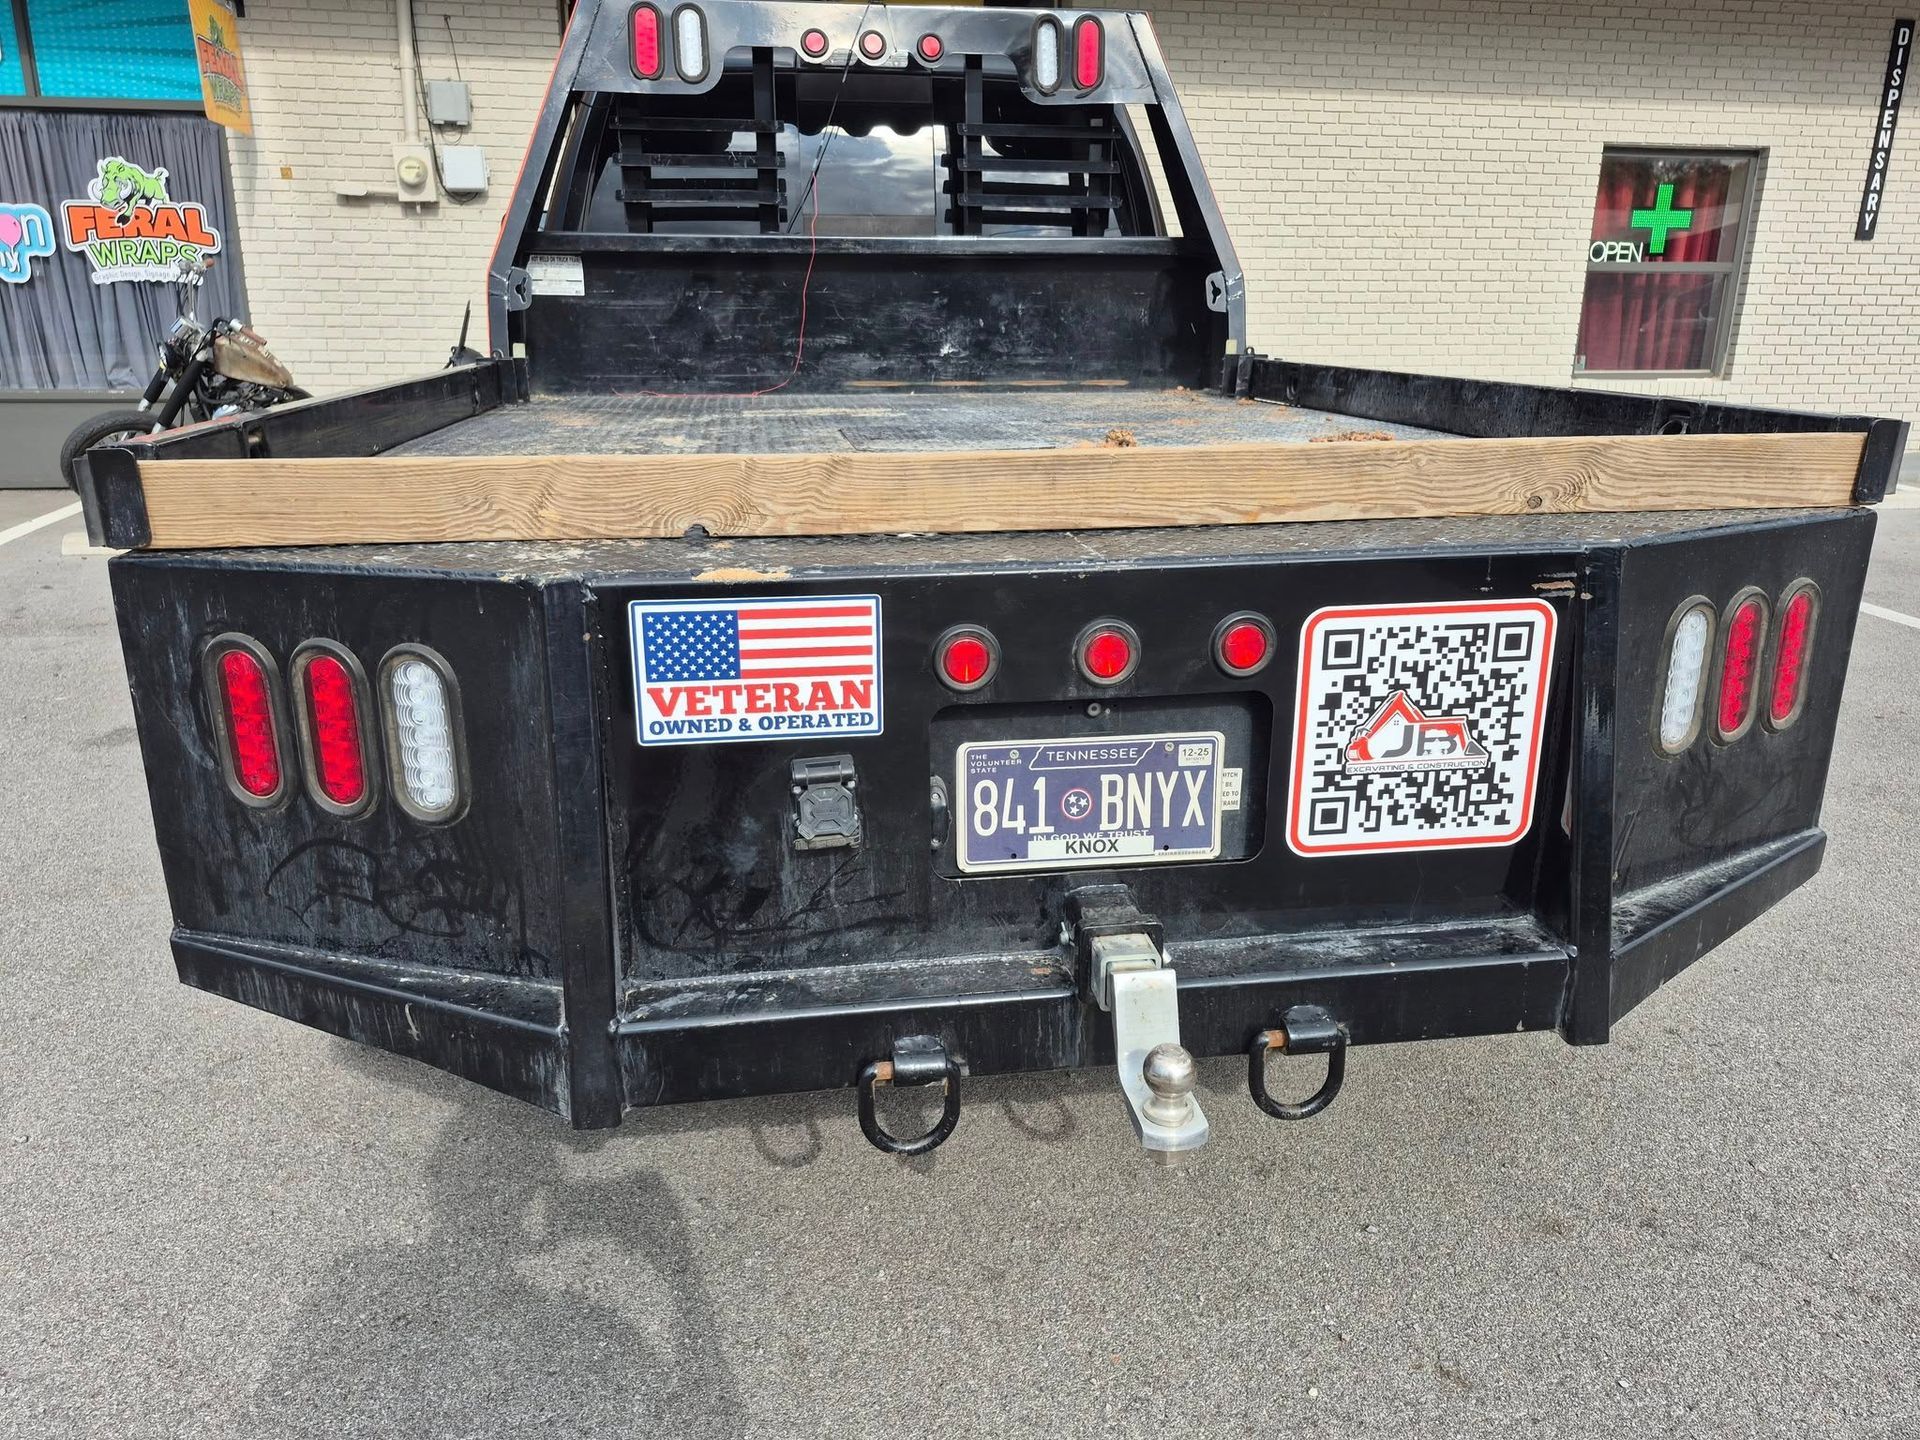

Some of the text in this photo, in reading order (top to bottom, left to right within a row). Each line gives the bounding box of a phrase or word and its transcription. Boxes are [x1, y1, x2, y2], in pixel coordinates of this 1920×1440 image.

[1863, 27, 1910, 231] DISPENSARY
[67, 205, 216, 247] FERAL
[89, 240, 198, 267] WRAPS
[1590, 241, 1643, 263] OPEN
[646, 680, 874, 717] VETERAN
[649, 712, 874, 735] OWNED & OPERATED
[970, 759, 1022, 767] VOLUNTEER
[1046, 747, 1139, 762] TENNESSEE
[1183, 747, 1210, 757] 12-25
[1347, 764, 1405, 774] EXCAVATING
[1416, 760, 1487, 769] CONSTRUCTION
[973, 770, 1207, 836] 841 BNYX
[1050, 833, 1079, 841] GOD
[1083, 831, 1101, 839] WE
[1107, 829, 1149, 838] TRUST
[1065, 838, 1119, 854] KNOX
